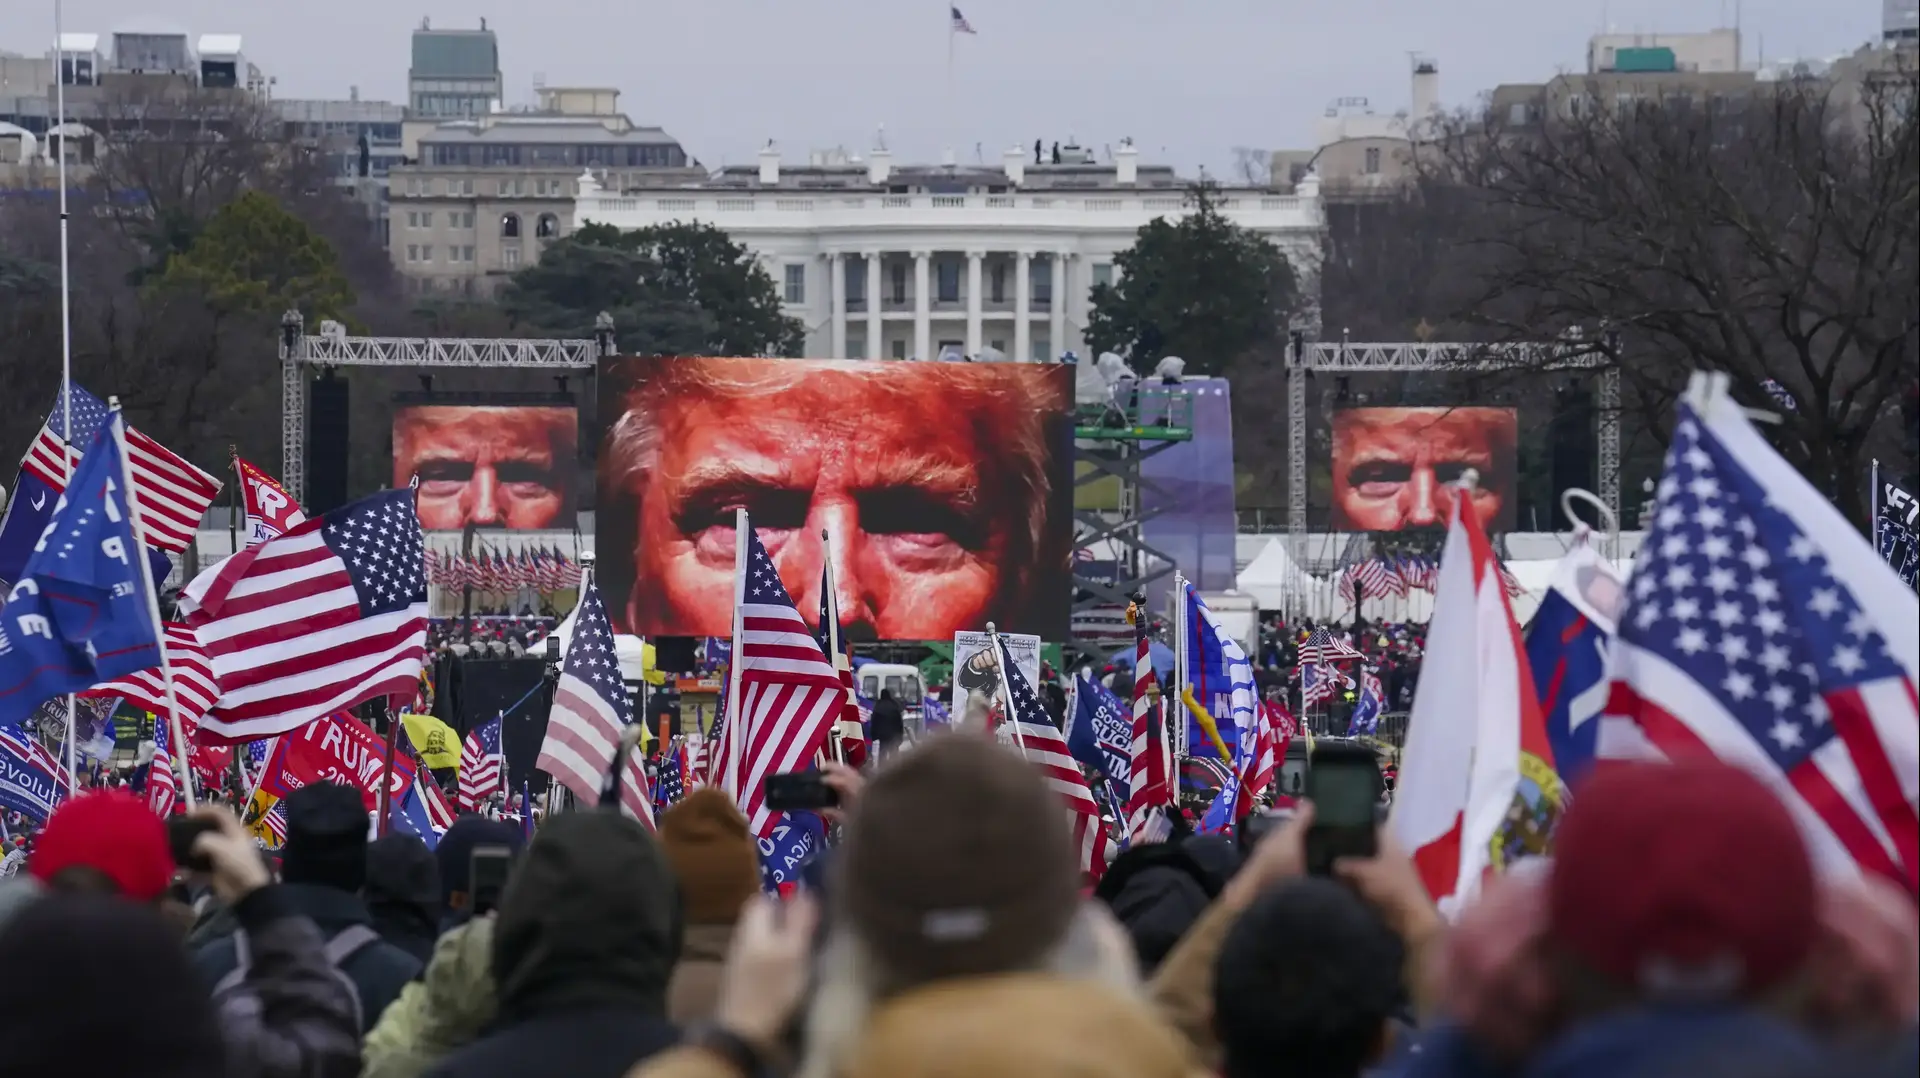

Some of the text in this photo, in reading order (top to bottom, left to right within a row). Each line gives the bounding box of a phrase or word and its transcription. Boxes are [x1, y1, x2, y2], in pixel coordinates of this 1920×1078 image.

[1096, 706, 1133, 740] Social
[304, 716, 403, 793] TRUMP
[0, 761, 63, 808] evoluti
[282, 769, 305, 790] KEEP
